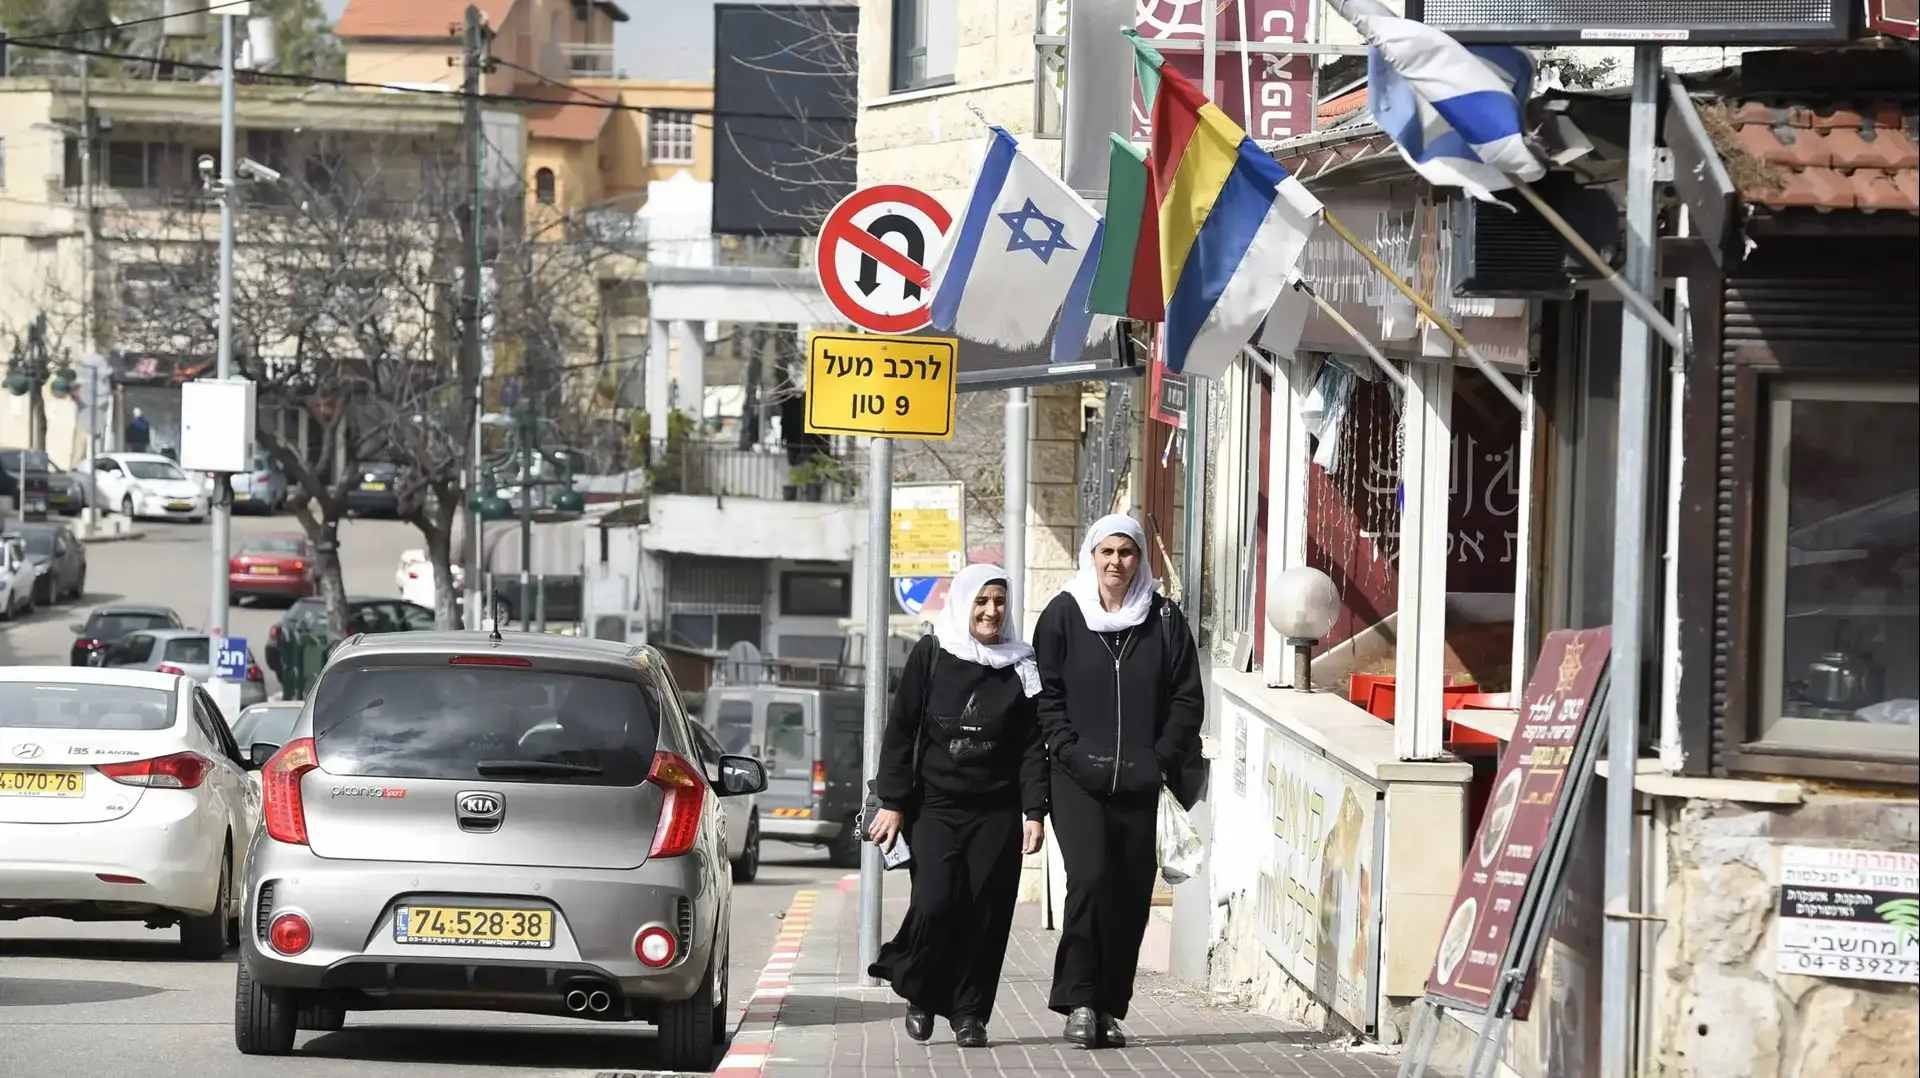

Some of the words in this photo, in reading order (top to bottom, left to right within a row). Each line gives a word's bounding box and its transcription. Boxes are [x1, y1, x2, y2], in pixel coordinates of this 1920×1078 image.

[823, 348, 873, 378] מעל
[883, 354, 942, 380] לרכב
[852, 393, 885, 419] טון
[895, 395, 910, 416] 9
[331, 784, 384, 799] picanto
[384, 787, 405, 798] Sport
[467, 799, 494, 812] KIA
